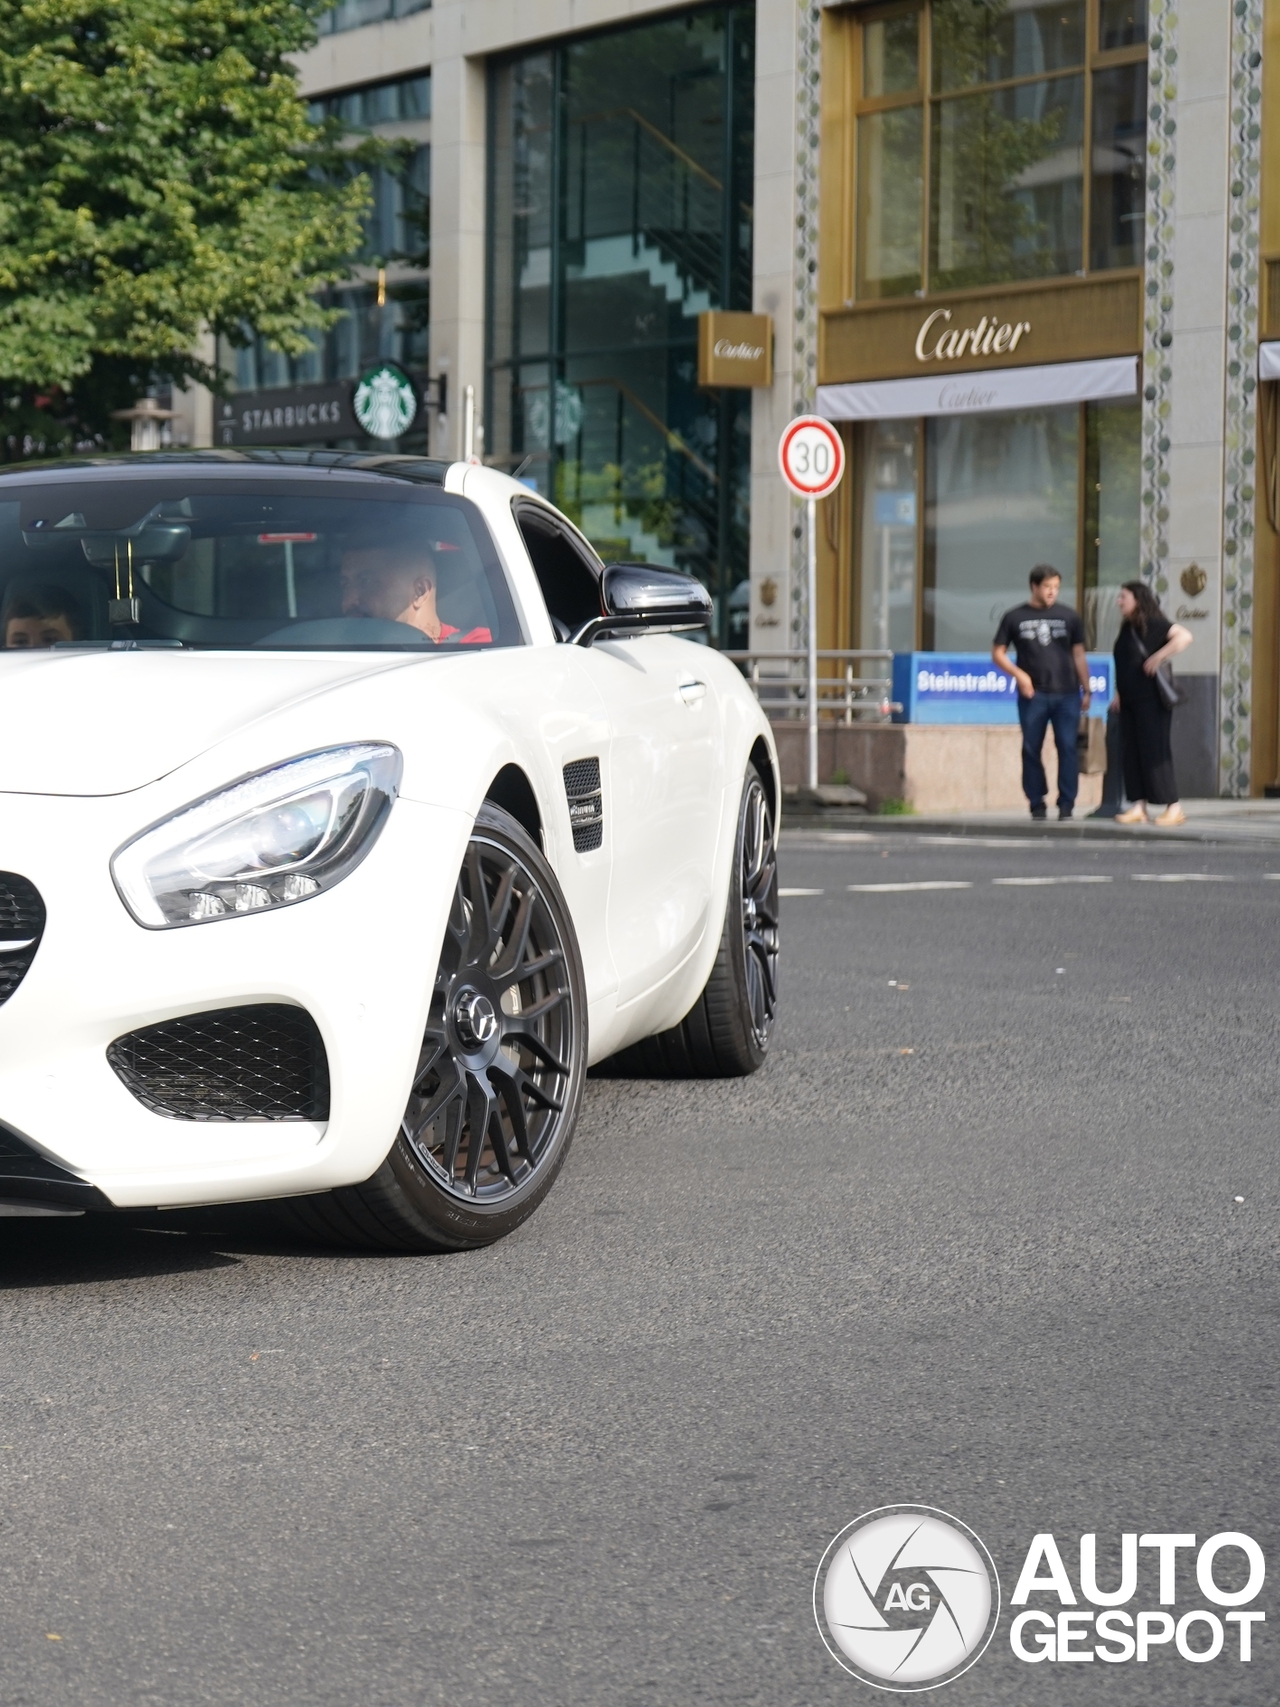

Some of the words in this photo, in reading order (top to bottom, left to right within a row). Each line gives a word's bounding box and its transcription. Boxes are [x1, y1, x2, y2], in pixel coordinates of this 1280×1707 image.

[714, 338, 765, 360] Cartier
[915, 308, 1032, 361] Cartier
[938, 382, 998, 409] Cartier
[242, 401, 341, 433] STARBUCKS
[795, 442, 829, 475] 30
[917, 670, 1008, 693] Steinstraße
